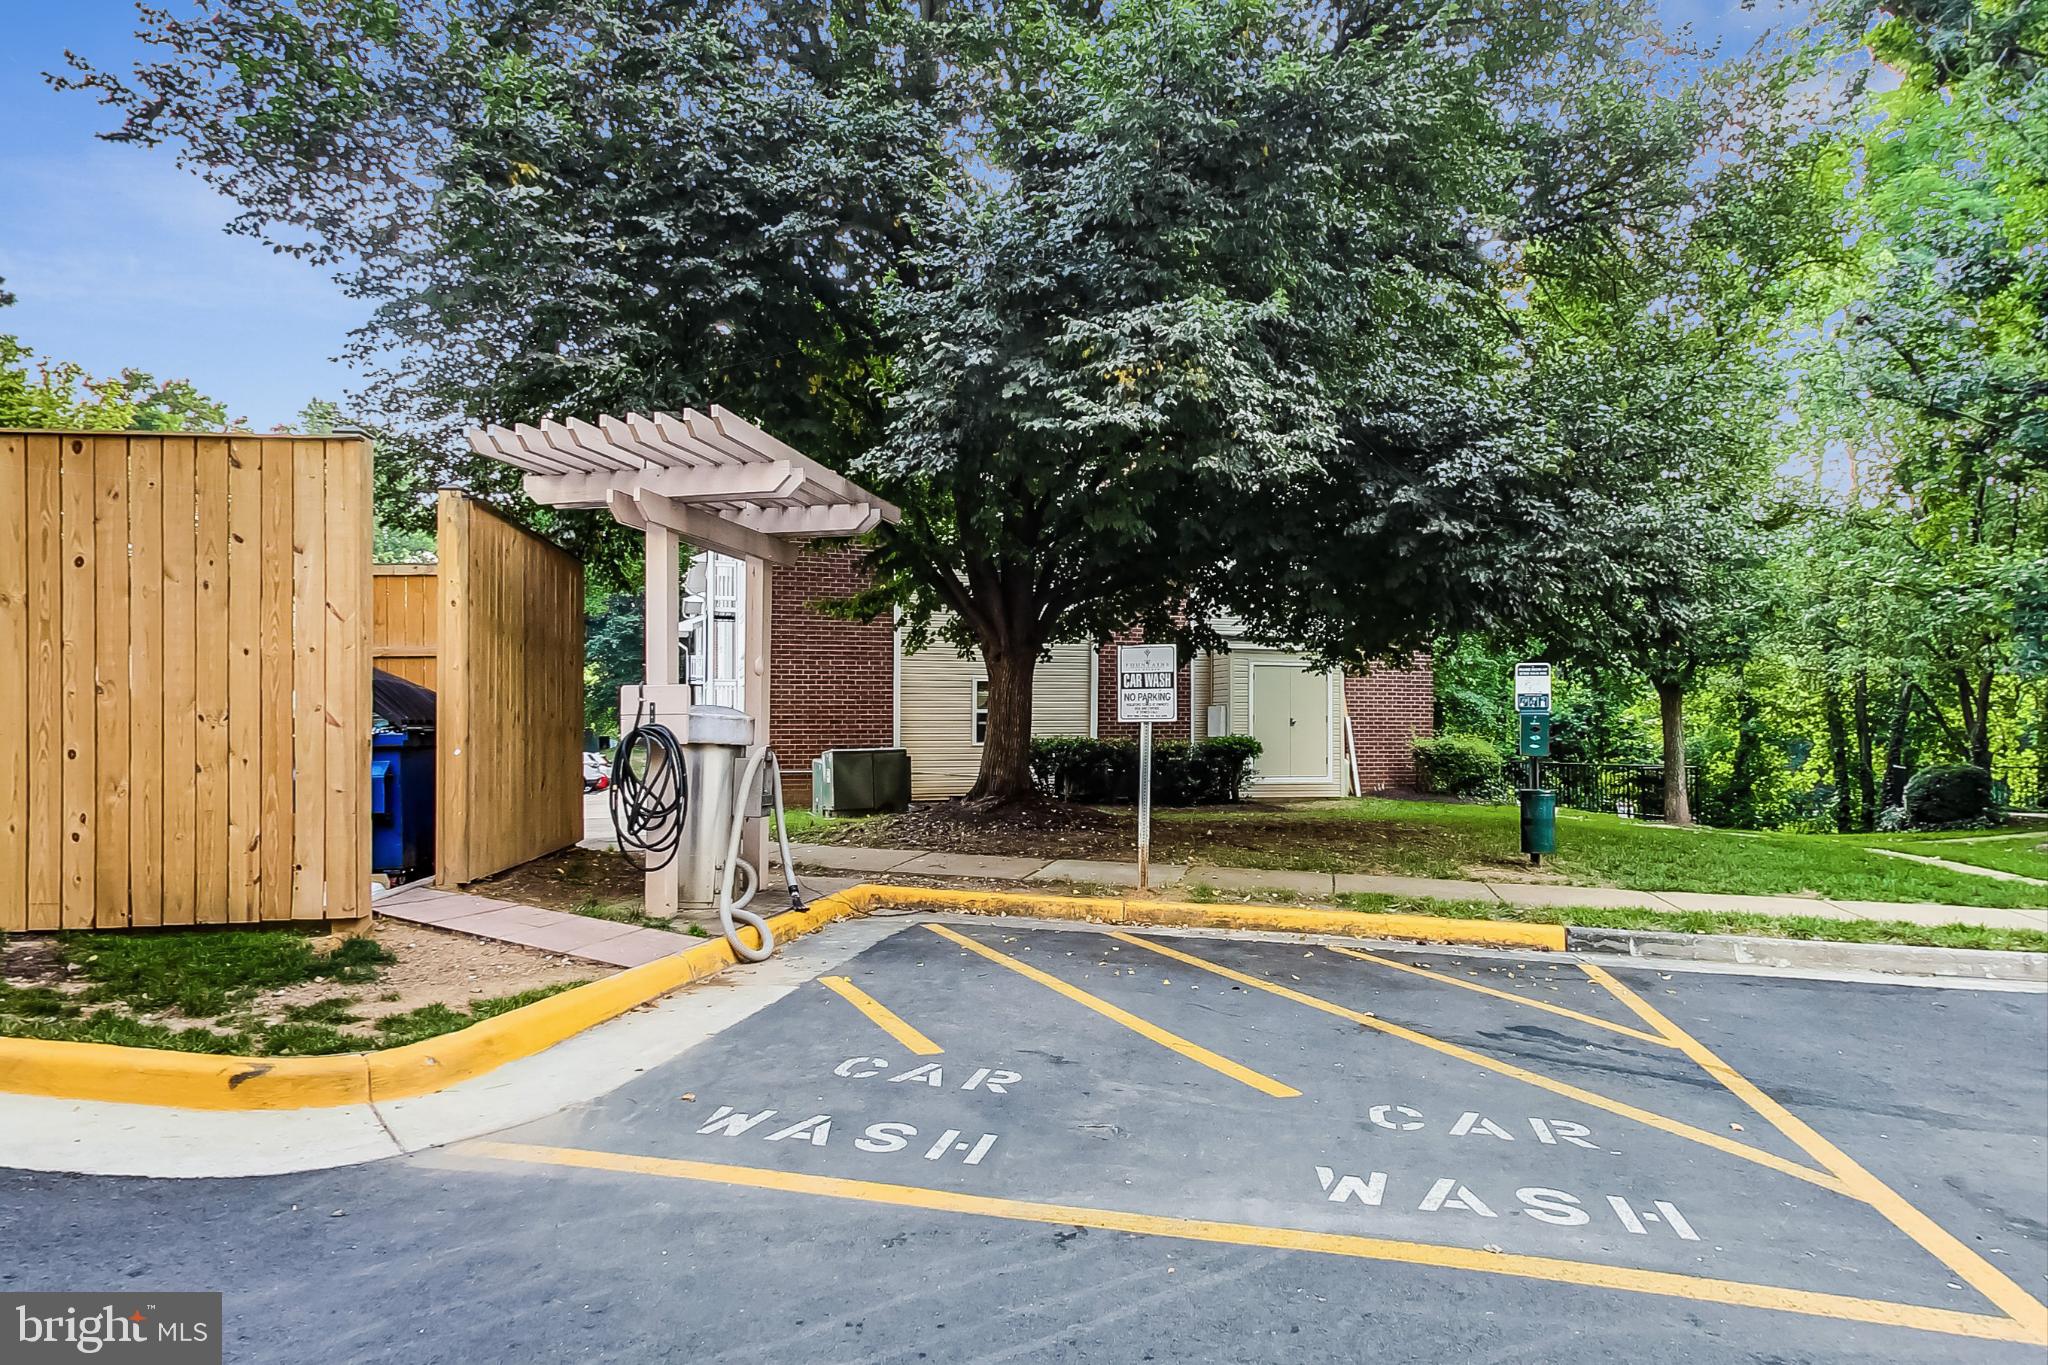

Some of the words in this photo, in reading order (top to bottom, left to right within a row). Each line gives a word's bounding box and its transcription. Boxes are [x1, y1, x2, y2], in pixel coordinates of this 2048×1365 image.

[1123, 673, 1143, 688] CAR
[1144, 673, 1171, 688] WASH
[1124, 692, 1136, 701] NO
[1138, 692, 1171, 701] PARKING
[834, 1056, 1023, 1094] CAR
[696, 1105, 999, 1165] WASH
[1368, 1104, 1600, 1149] CAR
[1315, 1165, 1701, 1241] WASH
